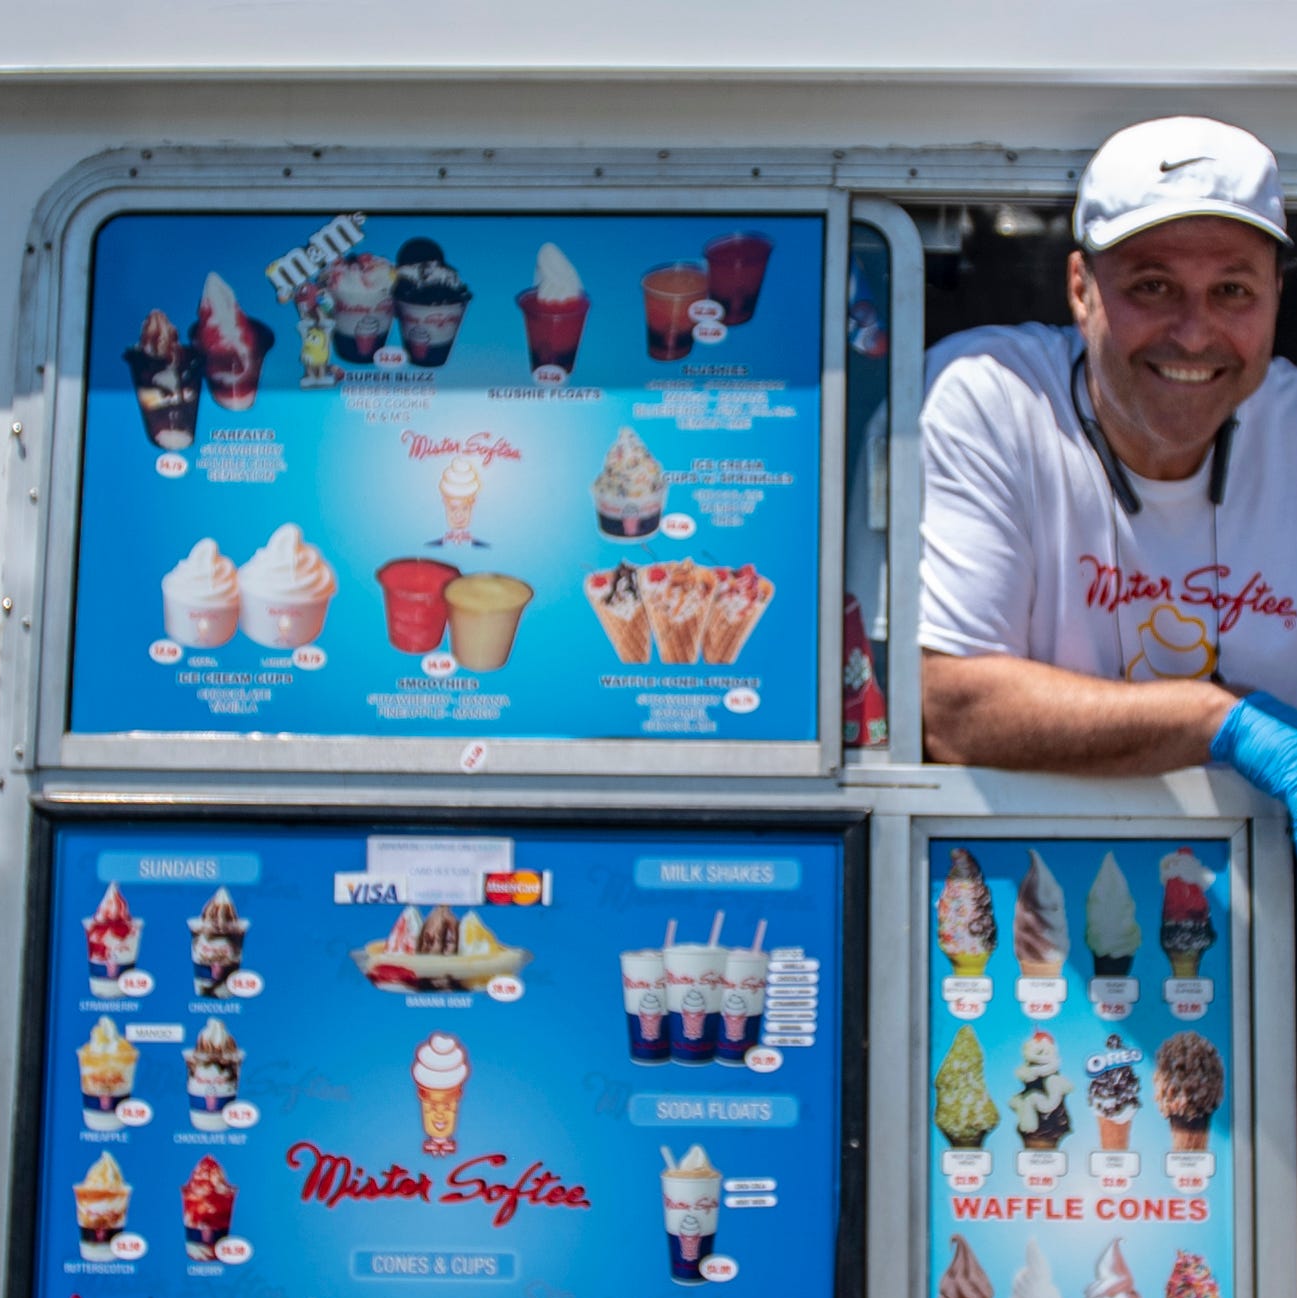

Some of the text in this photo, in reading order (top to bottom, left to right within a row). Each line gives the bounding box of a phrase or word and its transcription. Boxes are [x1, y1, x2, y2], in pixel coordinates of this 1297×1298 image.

[139, 859, 217, 878] SUNDAES
[660, 864, 774, 883] MILK SHAKES
[347, 881, 398, 904] VISA
[1088, 1050, 1143, 1073] OREO
[657, 1102, 772, 1121] SODA FLOATS
[286, 1141, 591, 1228] Mister Softee
[952, 1198, 1209, 1221] WAFFLE CONES
[372, 1256, 497, 1276] CONES & CUPS
